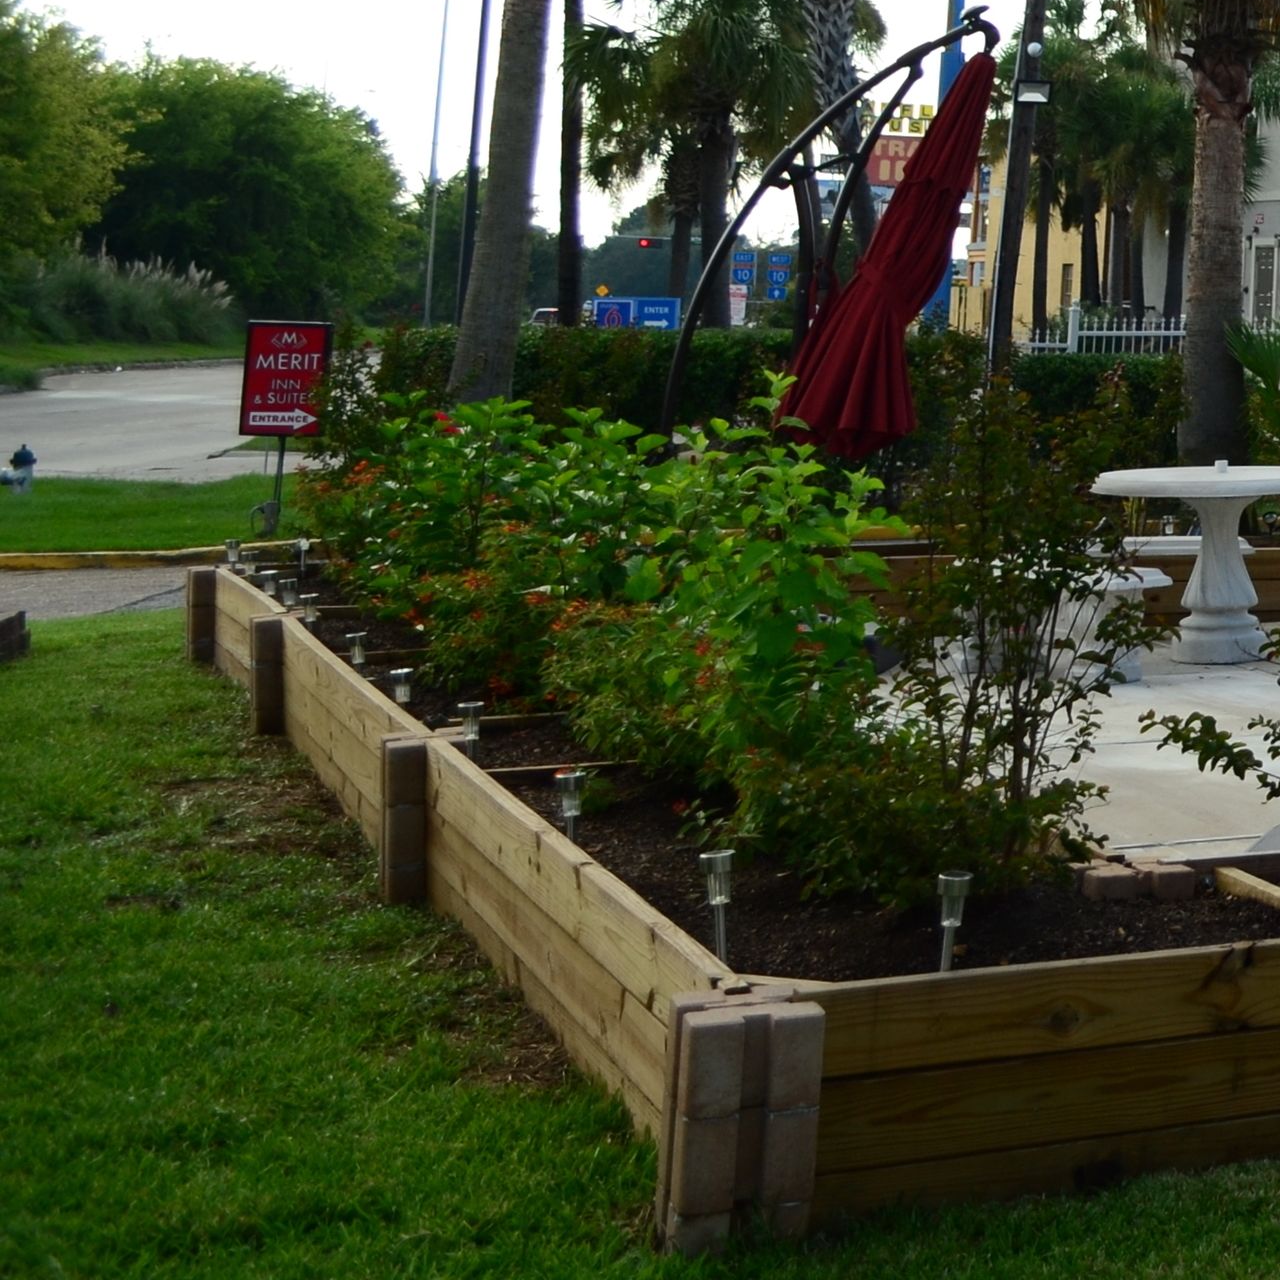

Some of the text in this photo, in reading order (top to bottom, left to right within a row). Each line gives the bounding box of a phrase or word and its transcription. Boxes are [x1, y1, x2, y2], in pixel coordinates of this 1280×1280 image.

[737, 270, 750, 280] 10
[773, 271, 785, 282] 10
[644, 306, 669, 314] ENTER
[256, 353, 321, 370] MERIT
[271, 379, 301, 390] INN
[252, 414, 309, 424] ENTRANCE
